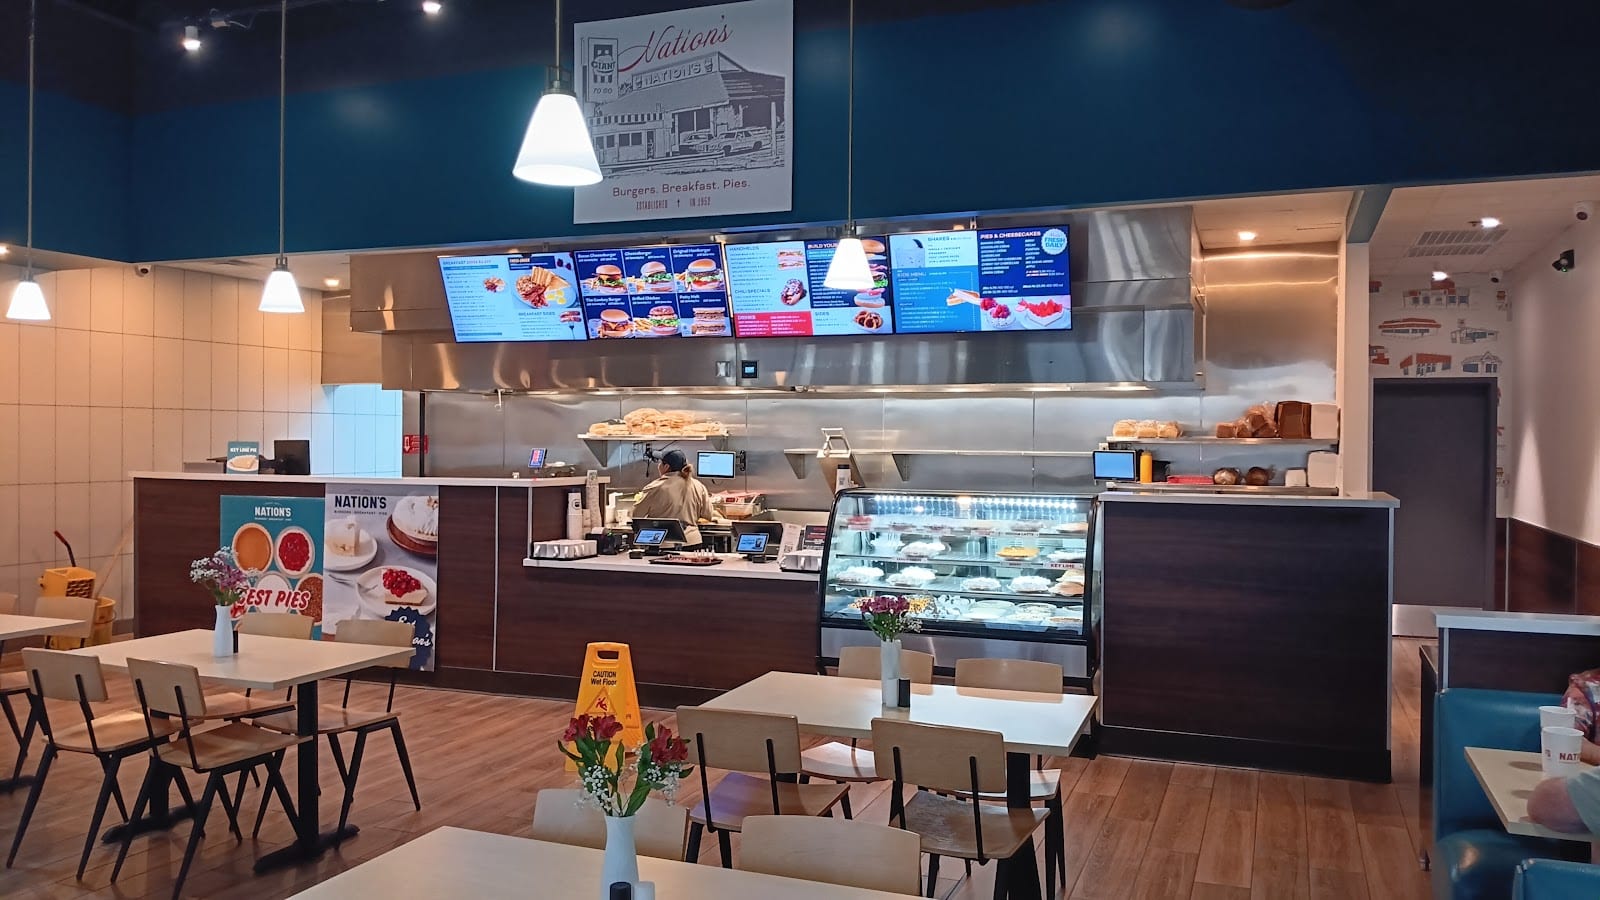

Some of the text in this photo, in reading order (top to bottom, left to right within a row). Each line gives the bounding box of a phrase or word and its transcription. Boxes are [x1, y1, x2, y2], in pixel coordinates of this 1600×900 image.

[618, 15, 733, 72] Nation's
[591, 60, 616, 70] GIANT
[645, 61, 705, 86] NATION'S
[613, 178, 750, 199] Burgers. Breakfast. Pies.
[636, 199, 668, 210] ESTABLISHED
[999, 231, 1041, 239] CHEESECAKES
[334, 495, 388, 509] NATION'S
[254, 506, 292, 517] NATION'S
[274, 590, 310, 609] PIES
[592, 670, 617, 678] CAUTION
